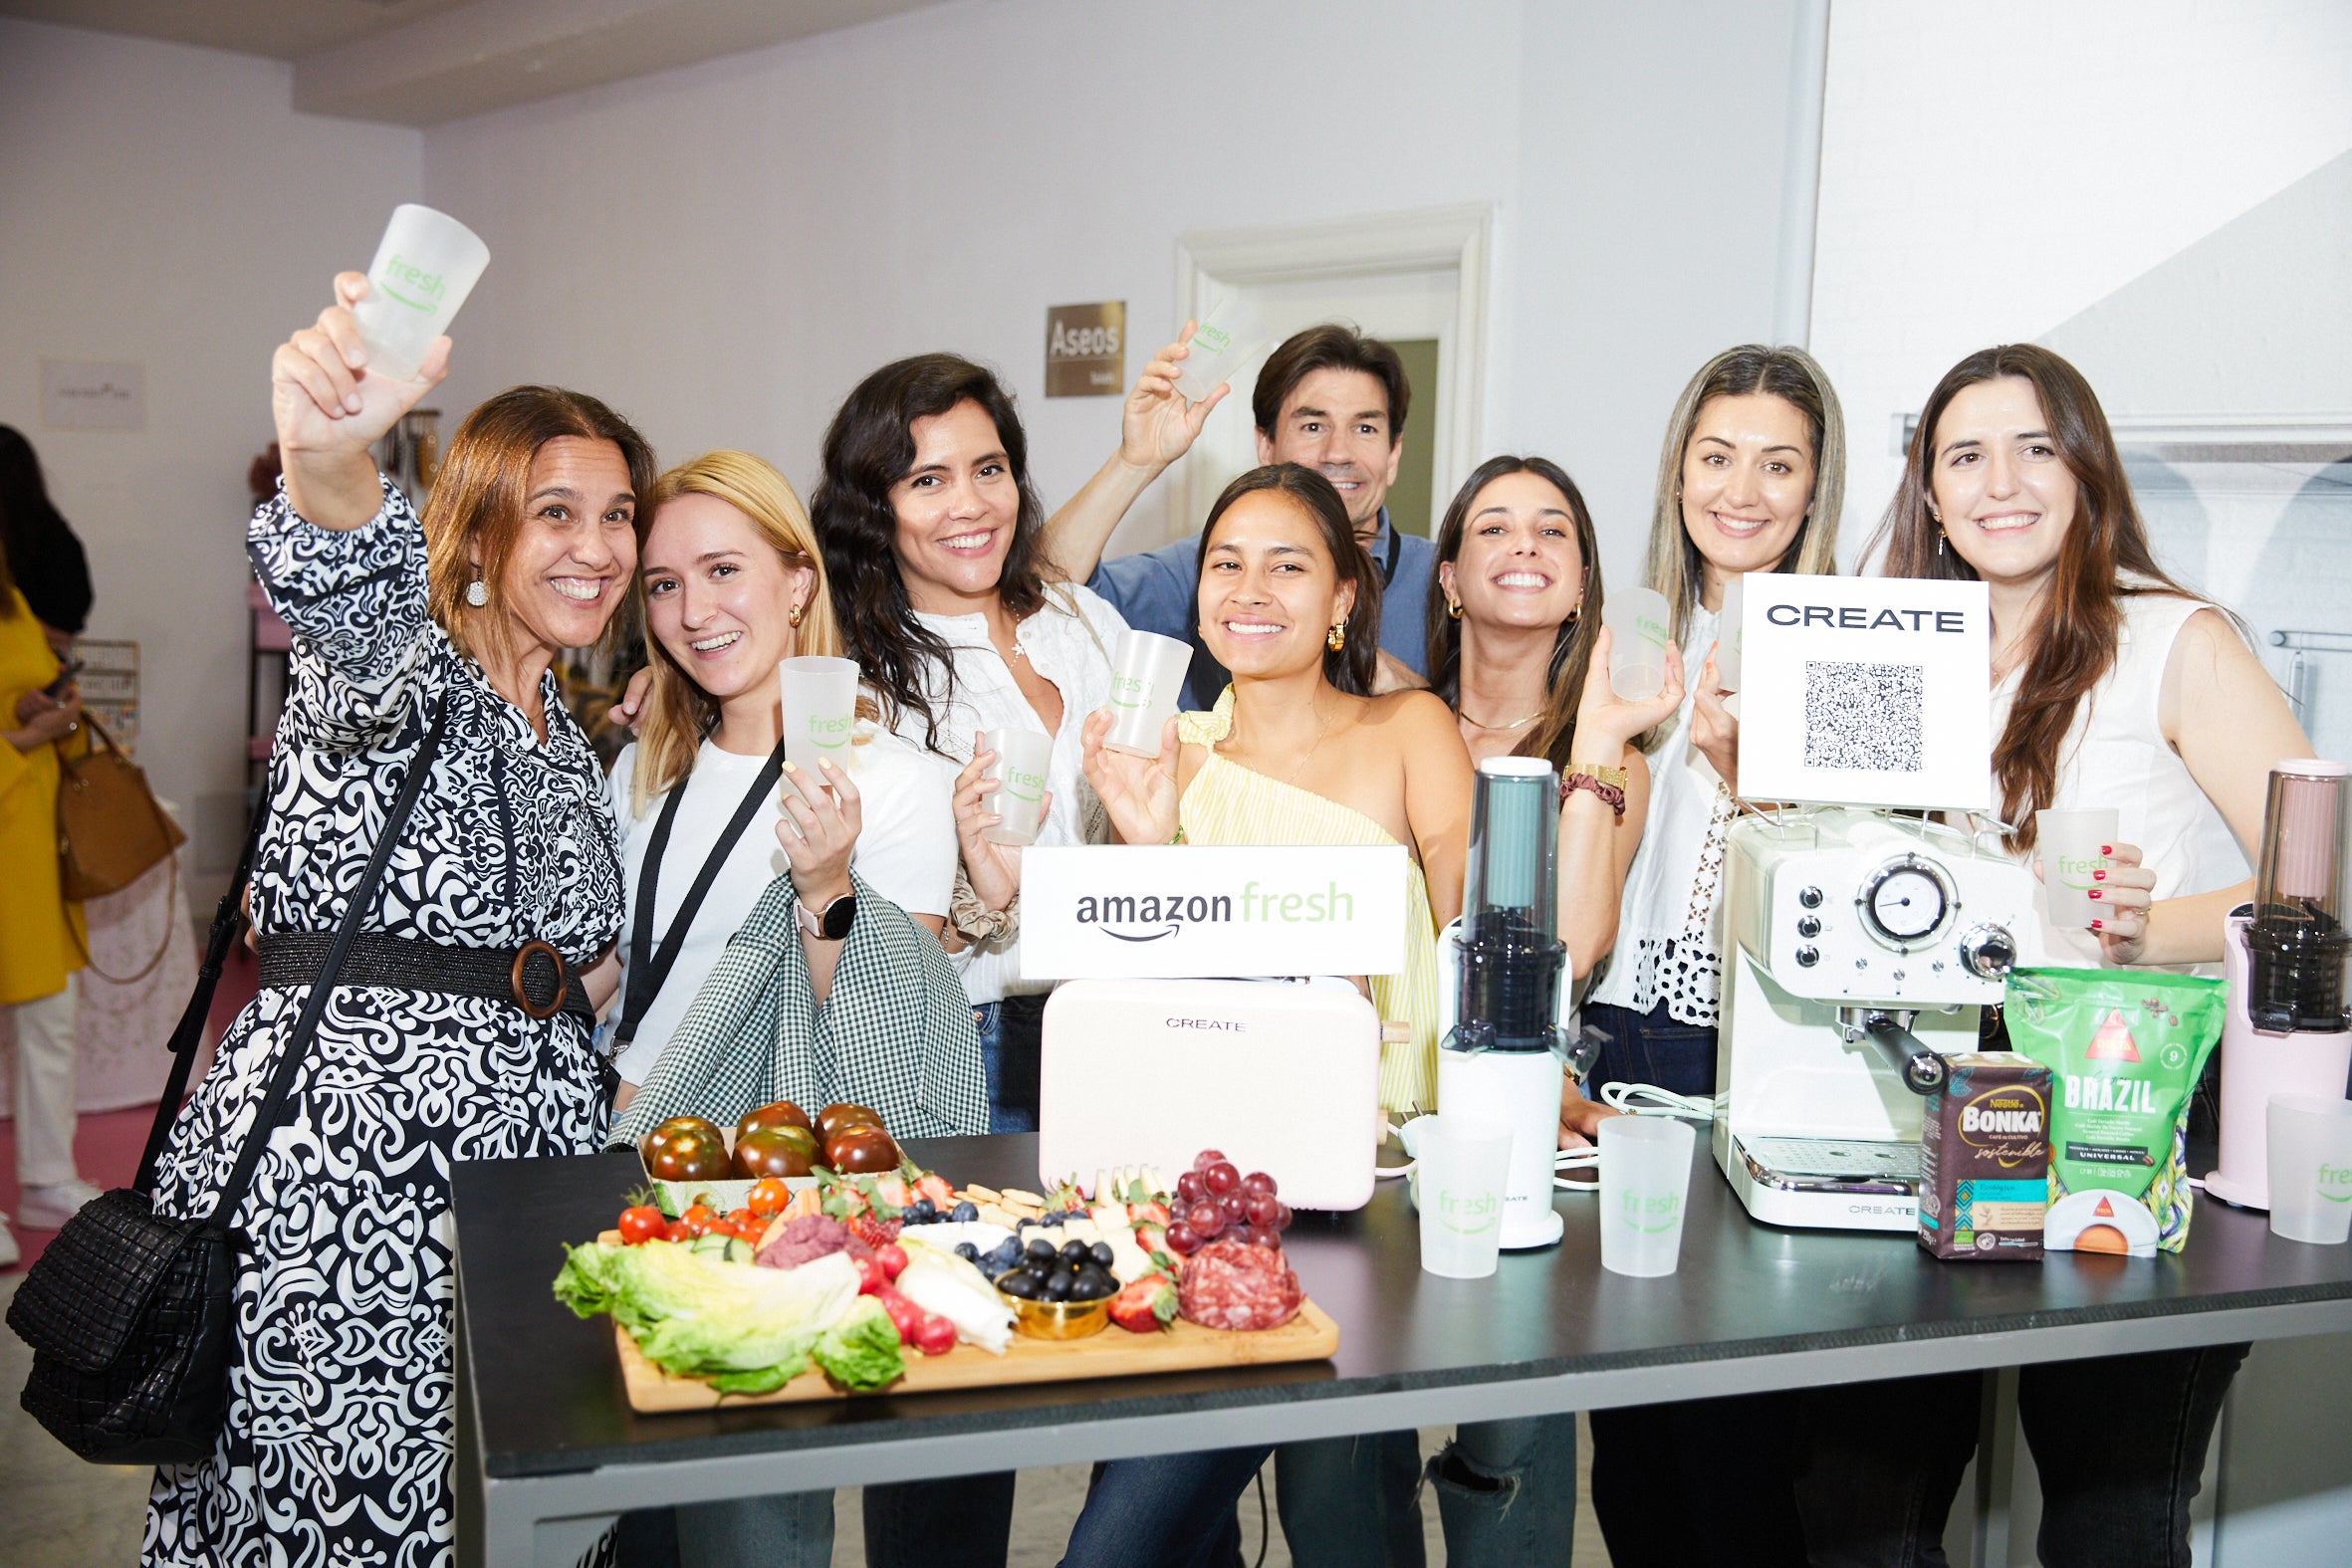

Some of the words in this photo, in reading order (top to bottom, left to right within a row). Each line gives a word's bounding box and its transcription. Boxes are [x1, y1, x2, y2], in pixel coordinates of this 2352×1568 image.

[385, 254, 447, 301] fresh
[1049, 319, 1119, 357] Aseos
[1199, 322, 1232, 347] fresh
[1766, 604, 1965, 633] CREATE
[1076, 895, 1231, 924] amazon
[1240, 881, 1353, 922] fresh
[1166, 1017, 1248, 1032] CREATE
[2170, 1050, 2178, 1062] 9
[2064, 1074, 2156, 1114] BRAZIL
[1963, 1106, 2040, 1132] BONKA
[1975, 1141, 2044, 1159] sostenible
[2080, 1151, 2135, 1161] UNIVERSAL
[2318, 1163, 2352, 1185] fre
[1438, 1190, 1497, 1215] fresh
[1622, 1189, 1679, 1214] fresh
[1849, 1206, 1915, 1216] CREATE
